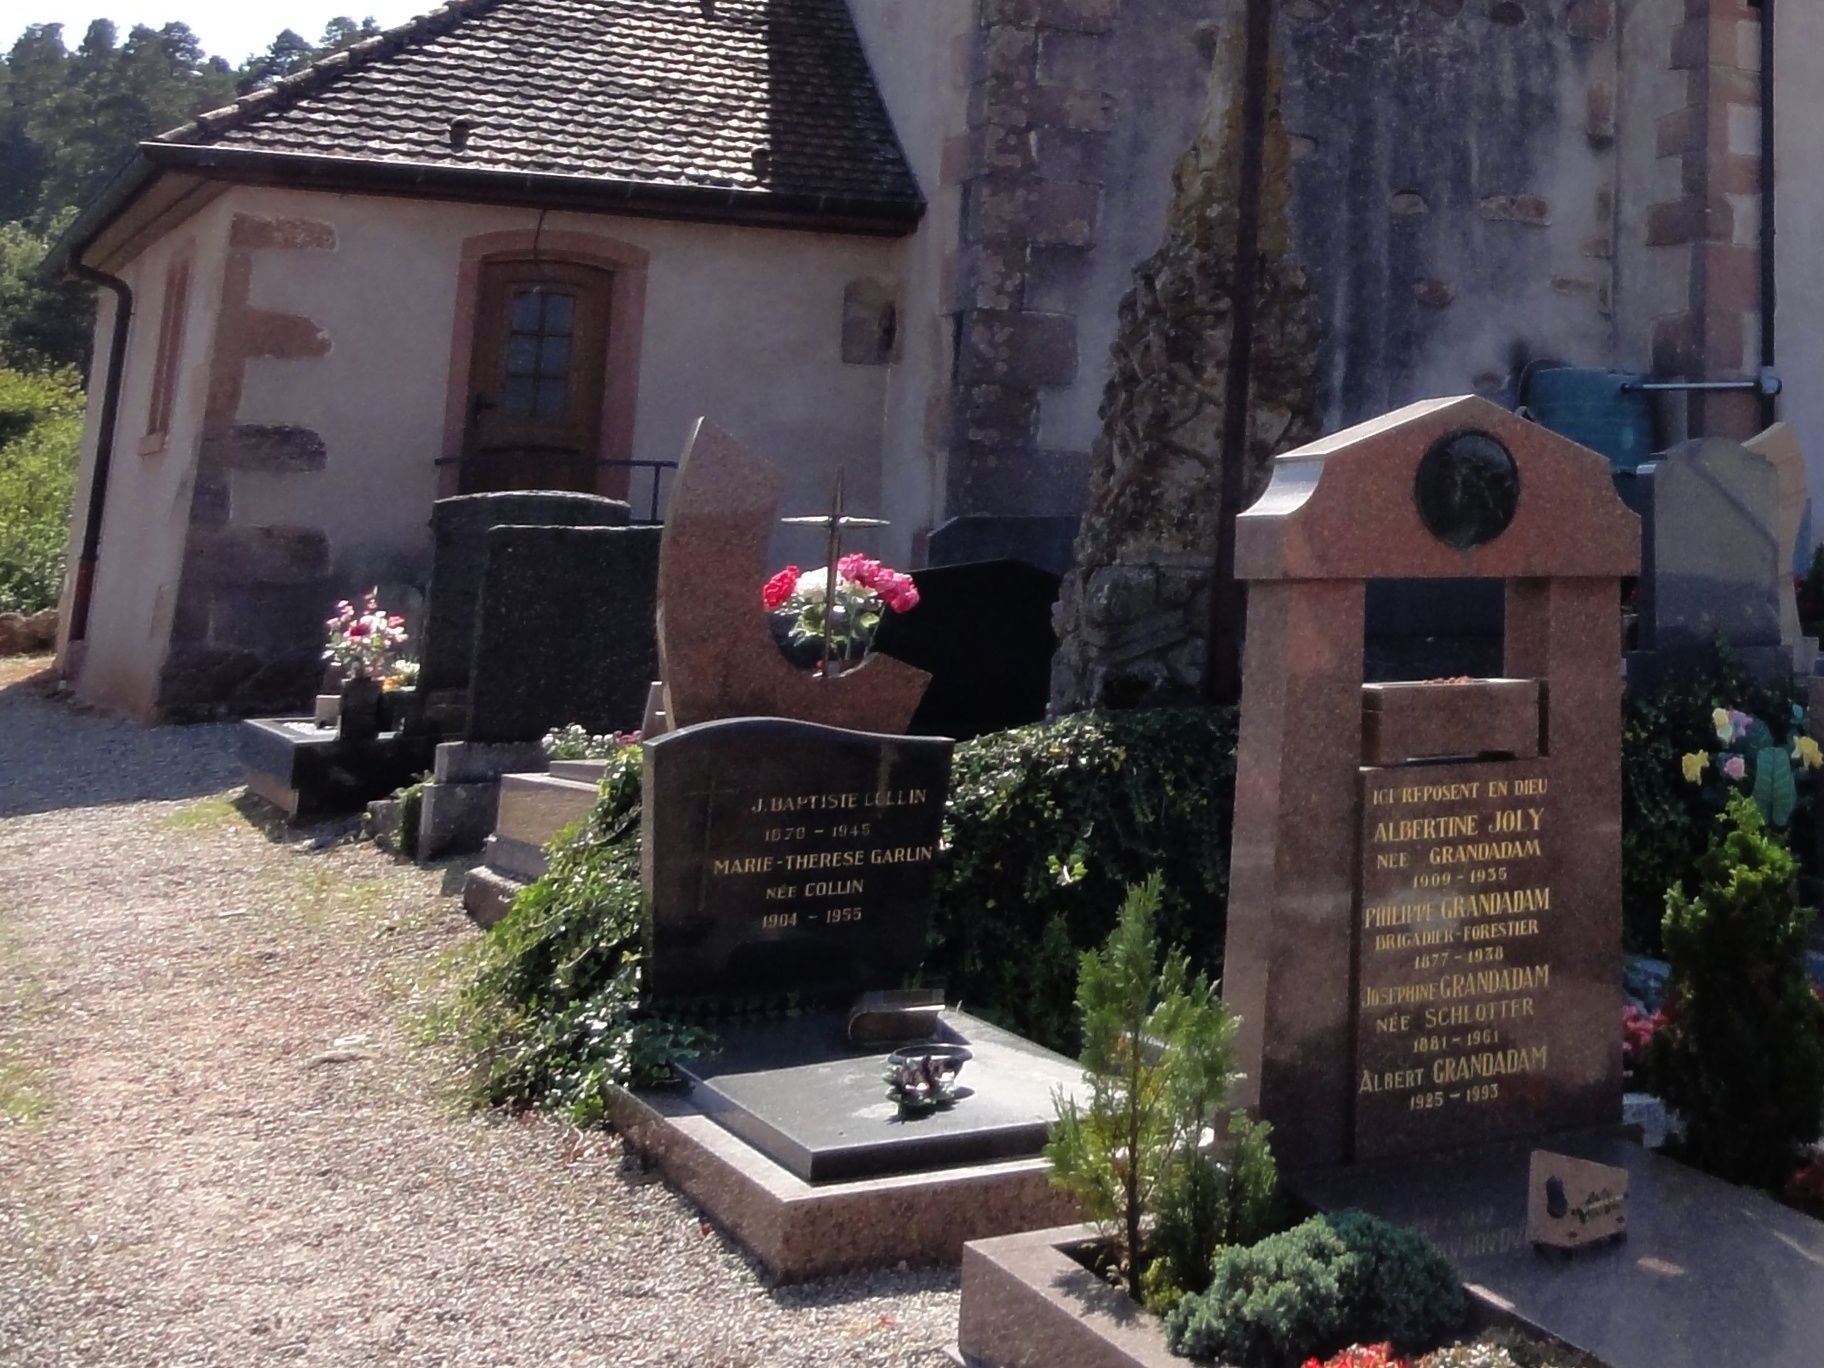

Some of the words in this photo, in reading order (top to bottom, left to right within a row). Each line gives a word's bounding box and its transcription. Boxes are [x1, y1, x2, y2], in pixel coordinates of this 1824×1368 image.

[1373, 788, 1394, 805] ICI
[1402, 782, 1480, 803] REPOSENT
[1488, 781, 1508, 798] EN
[1514, 778, 1548, 795] DIEU
[1374, 815, 1479, 843] ALBERTINE
[1488, 808, 1545, 833] JOLY
[871, 846, 933, 863] GARLIN
[1429, 839, 1541, 865] GRANDADAM
[805, 879, 864, 897] COLLIN
[762, 912, 798, 928] 1904
[826, 907, 863, 923] 1955
[1364, 901, 1433, 929] PHILIPPE
[1441, 887, 1551, 920] GRANDADAM
[1414, 952, 1449, 970] 1877
[1467, 946, 1504, 964] 1938
[1361, 982, 1437, 1008] JOSEPHINE
[1439, 964, 1550, 1000] GRANDADAM
[1425, 996, 1535, 1029] SCHLOTTER
[1413, 1035, 1447, 1053] 1881
[1467, 1030, 1499, 1047] 1961
[1358, 1068, 1425, 1094] ALBERT
[1433, 1045, 1548, 1085] GRANDADAM
[1410, 1091, 1444, 1111] 1925
[1466, 1083, 1499, 1103] 1993
